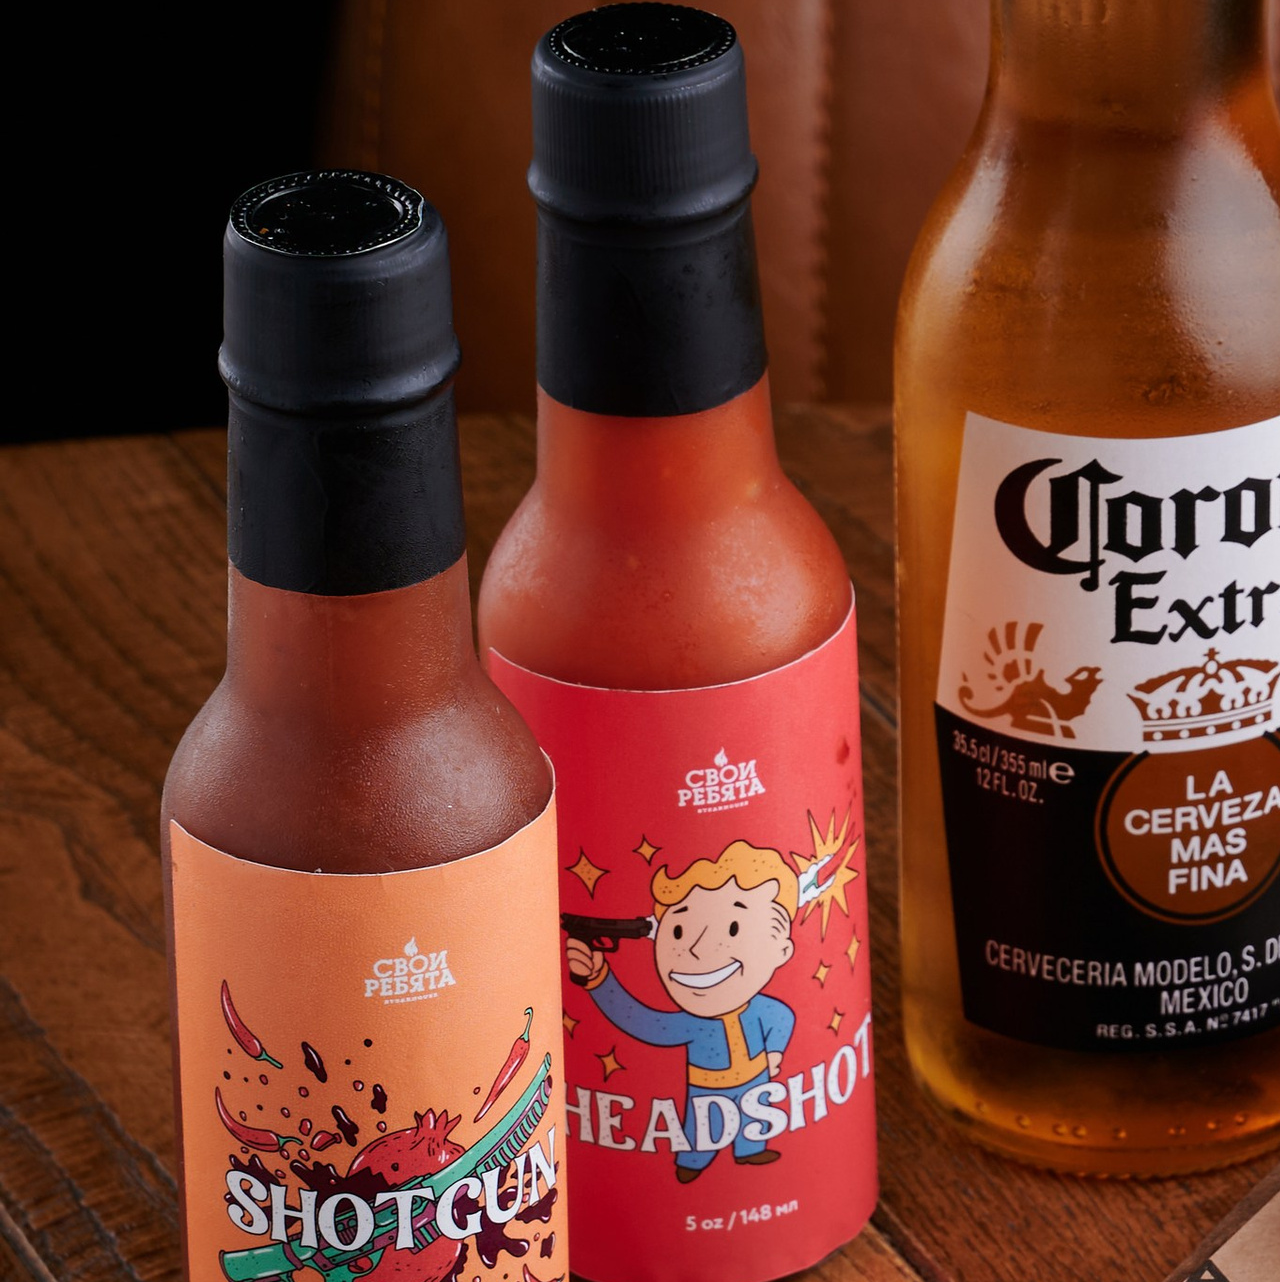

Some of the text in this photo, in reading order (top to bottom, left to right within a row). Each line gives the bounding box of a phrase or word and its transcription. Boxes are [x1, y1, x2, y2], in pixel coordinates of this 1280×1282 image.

[685, 759, 757, 788] СВОИ
[1186, 770, 1234, 801] LA
[677, 777, 766, 807] РЕБЯТА
[1171, 827, 1247, 864] MAS
[1168, 859, 1248, 895] FINA
[373, 949, 448, 978] СВОИ
[985, 939, 1127, 987] CERVECERIA
[1134, 951, 1238, 986] MODELO,
[1241, 945, 1262, 972] S.
[364, 968, 457, 998] РЕБЯТА
[1160, 976, 1249, 1015] MEXICO
[1097, 1023, 1141, 1039] REG.
[1233, 1003, 1268, 1025] 7417
[565, 1013, 871, 1153] HEADSHOT
[226, 1124, 557, 1251] SHOTGUN
[686, 1216, 697, 1231] 5
[701, 1218, 724, 1230] oz
[740, 1204, 772, 1225] 148
[776, 1200, 799, 1216] мл
